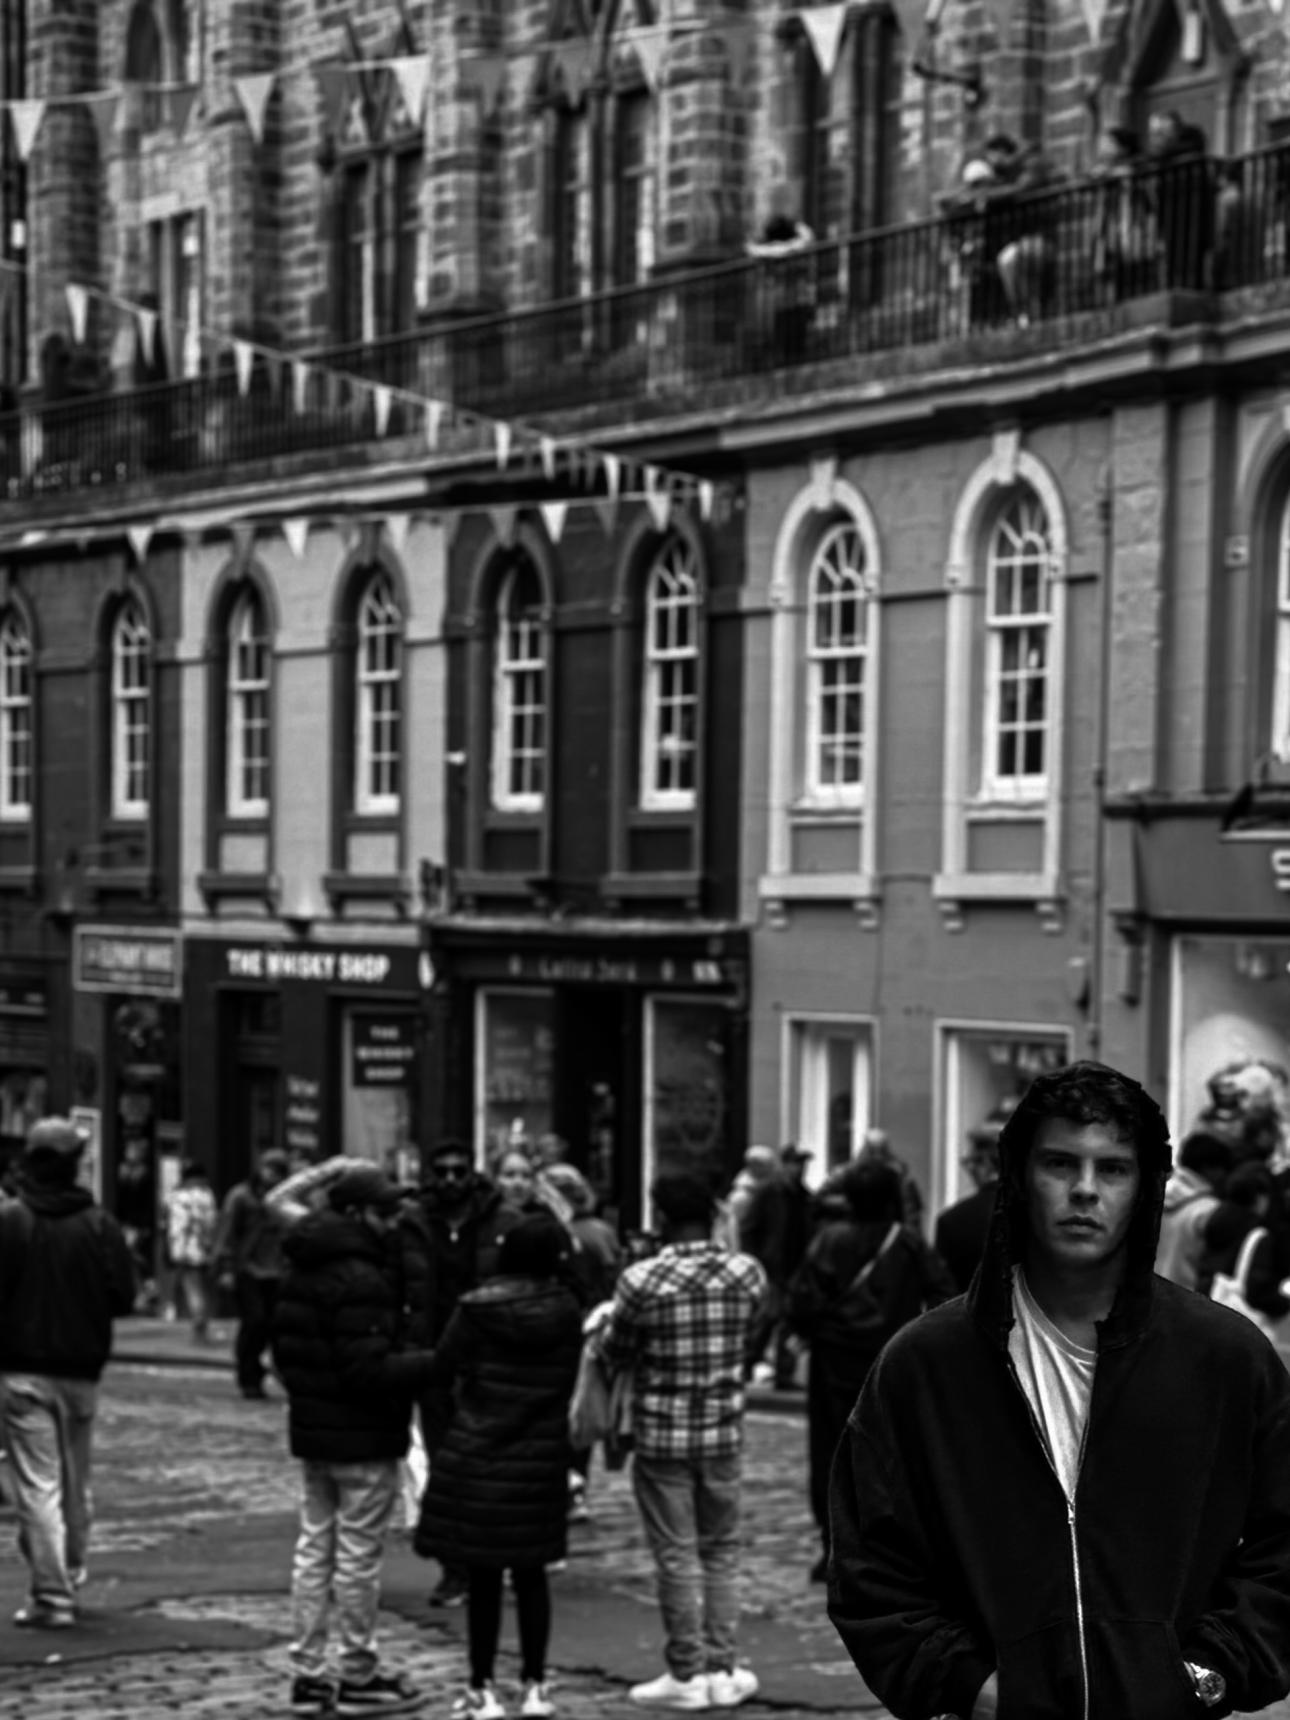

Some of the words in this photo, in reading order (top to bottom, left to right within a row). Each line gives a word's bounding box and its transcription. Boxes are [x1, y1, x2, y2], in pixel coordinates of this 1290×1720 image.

[228, 949, 262, 977] THE
[266, 951, 333, 980] WHISKY
[338, 953, 390, 982] SHOP
